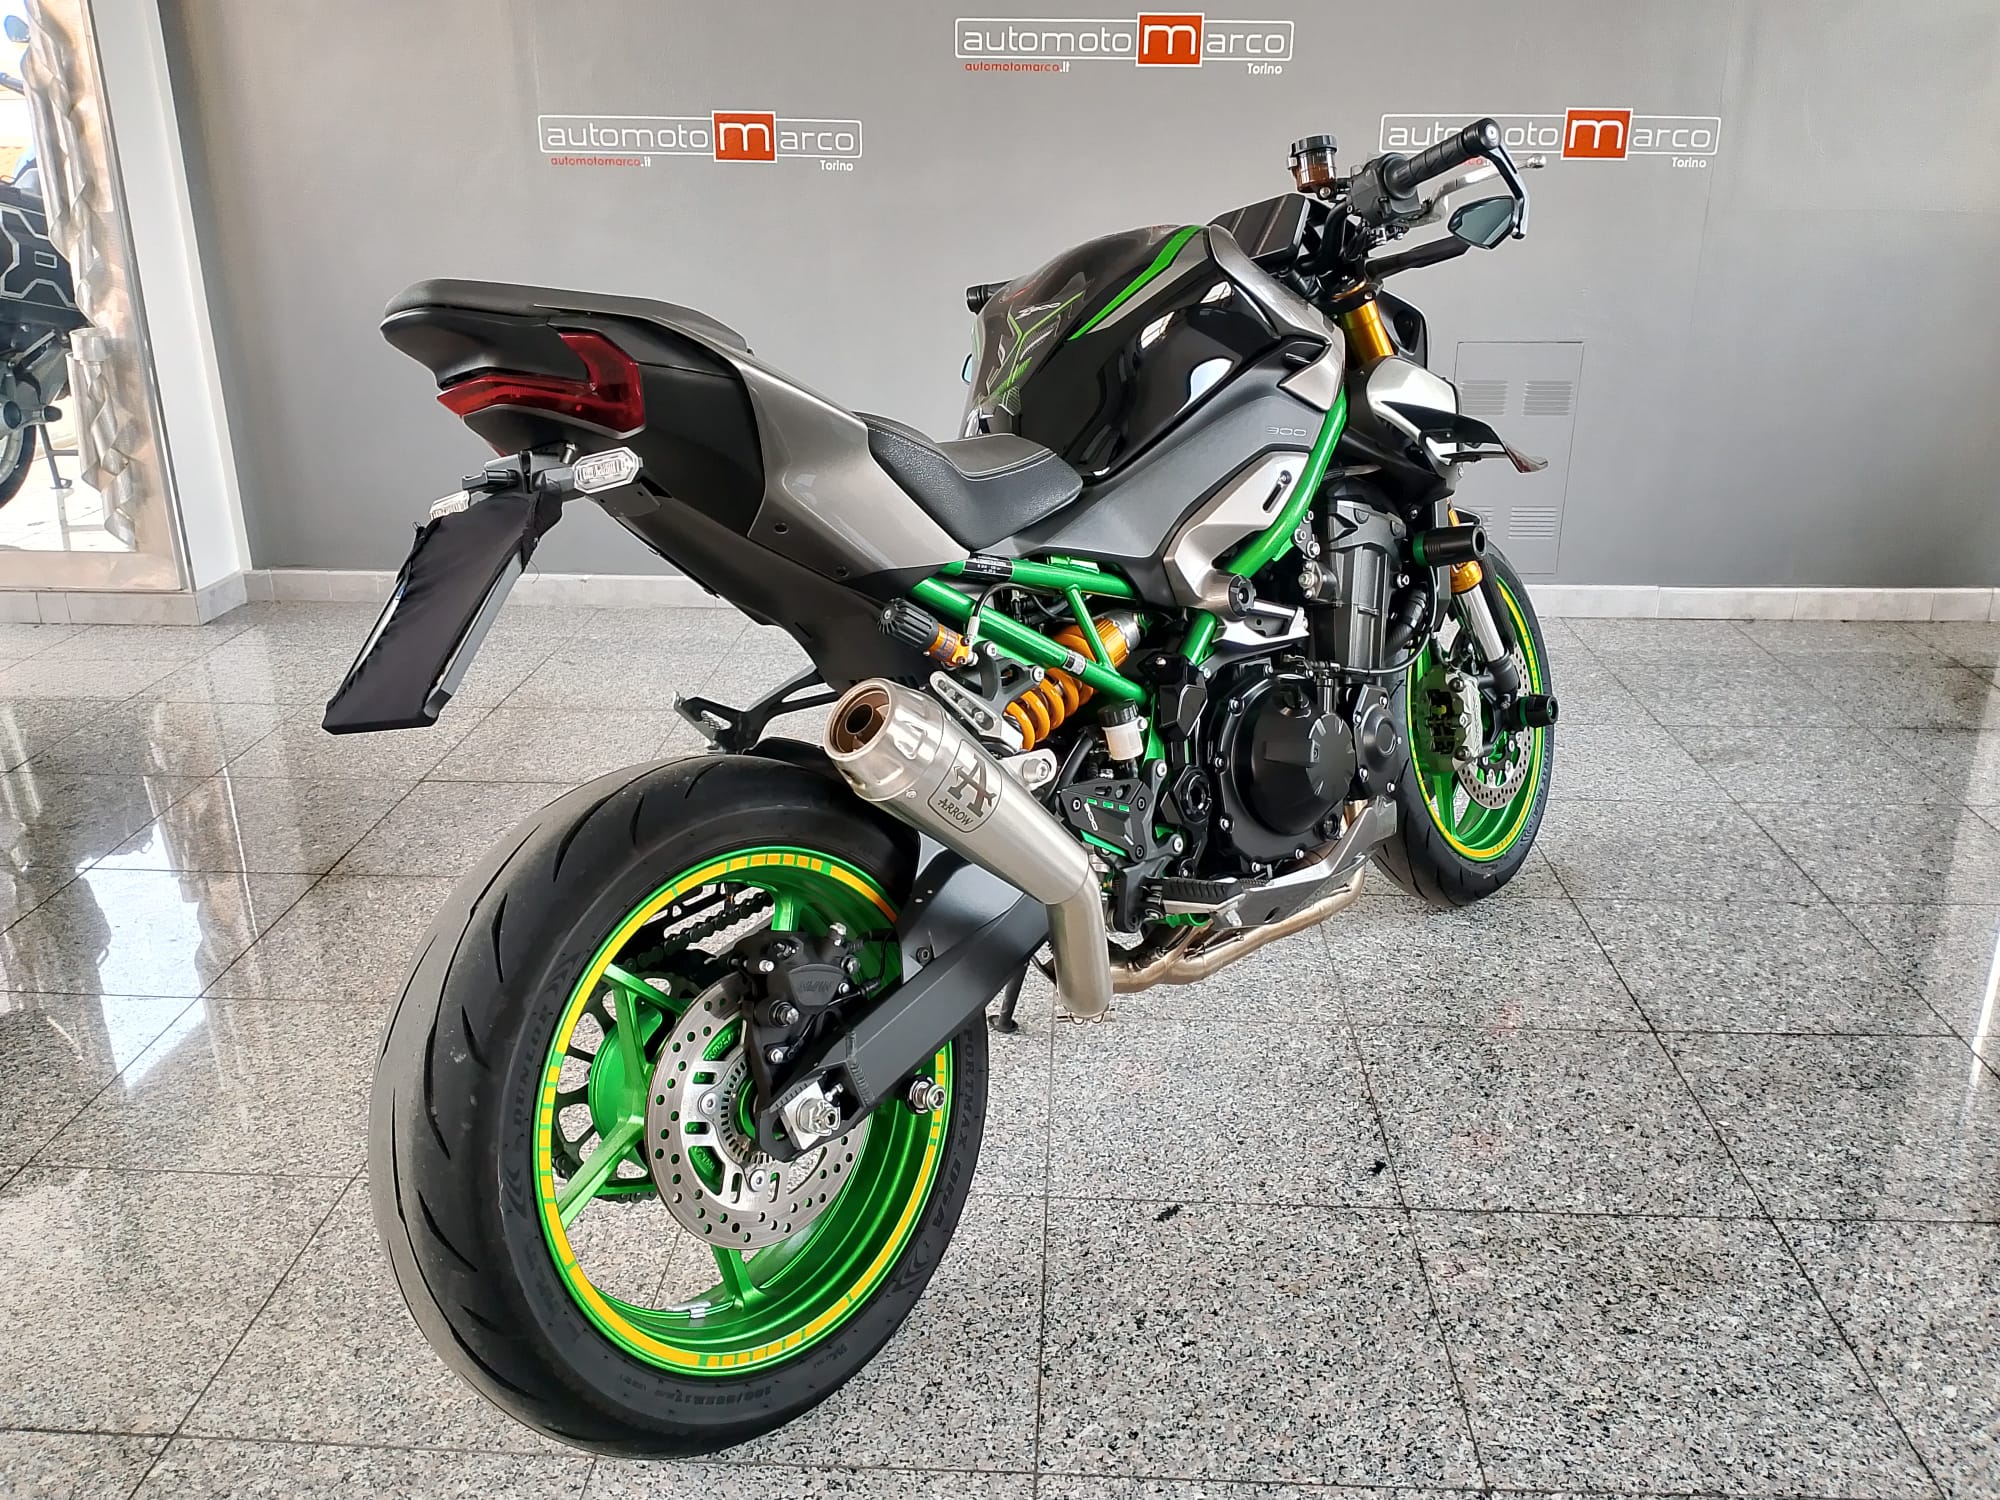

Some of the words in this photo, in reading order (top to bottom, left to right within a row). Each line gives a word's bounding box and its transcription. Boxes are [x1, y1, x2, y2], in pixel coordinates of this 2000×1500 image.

[963, 26, 1132, 52] automoto
[1247, 63, 1283, 75] Torino
[547, 122, 709, 148] automoto
[551, 156, 651, 168] automotomarco.it
[820, 159, 854, 172] Torino
[1671, 157, 1707, 169] Torino
[937, 797, 974, 826] ARROW
